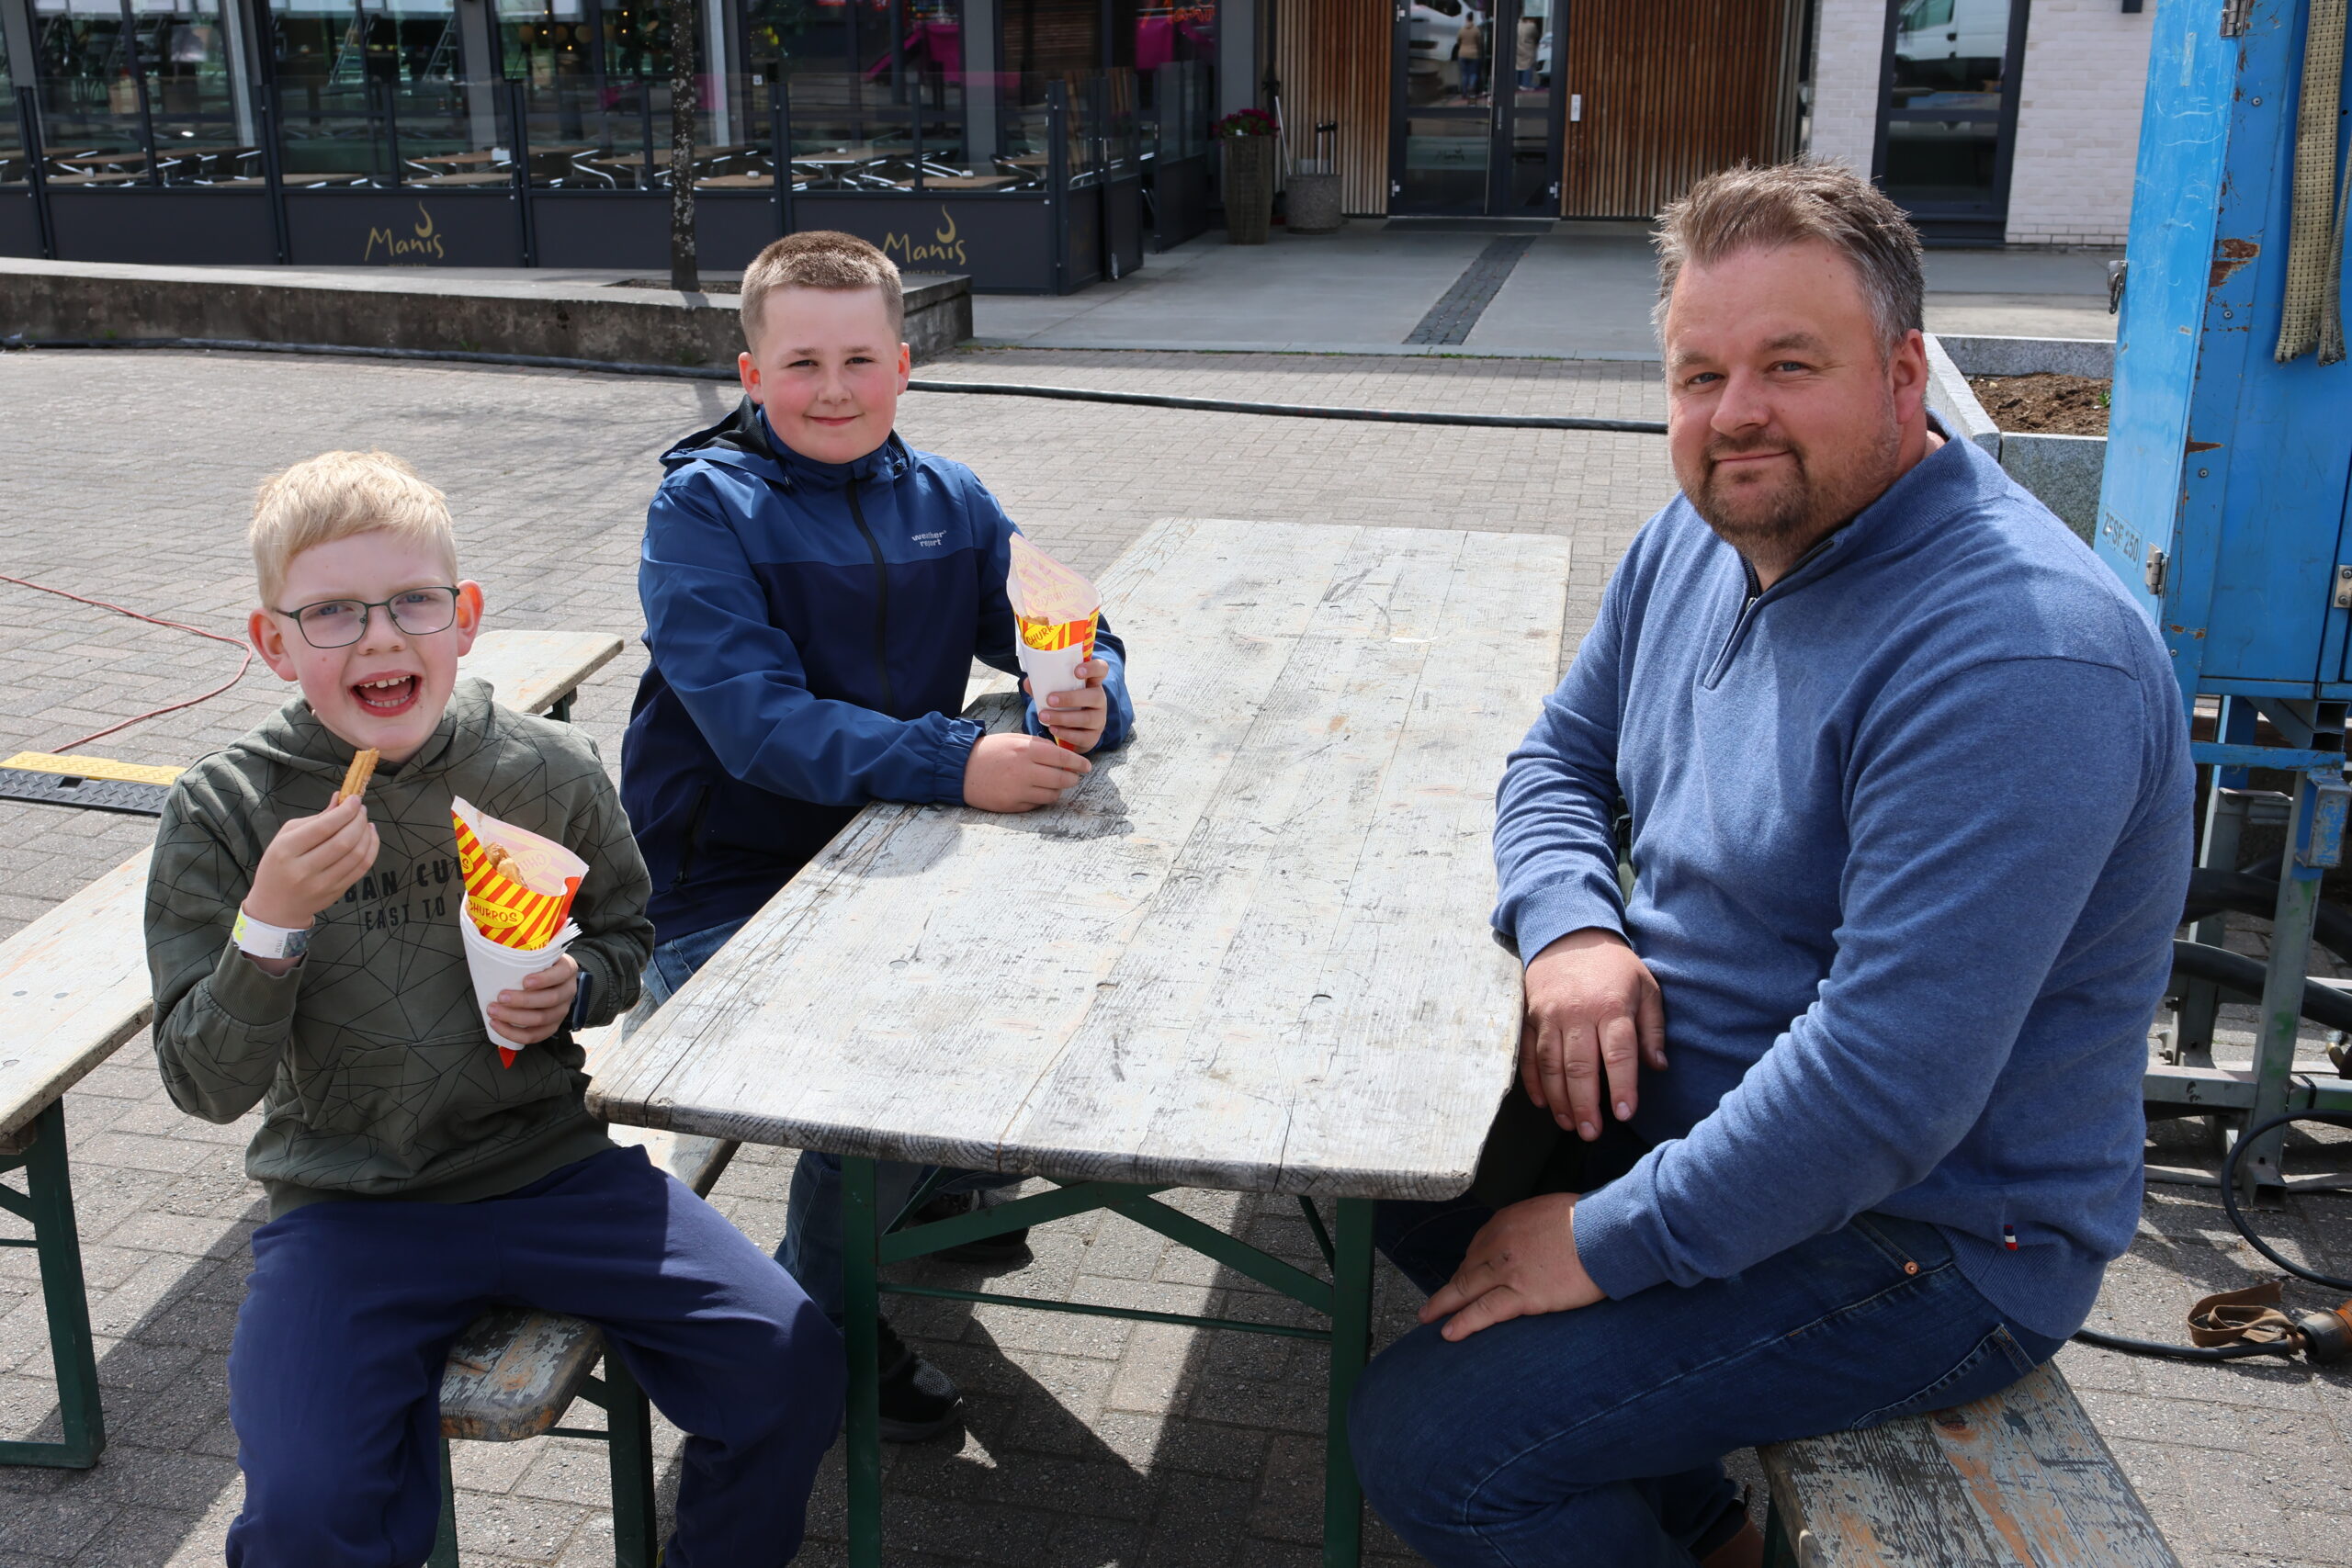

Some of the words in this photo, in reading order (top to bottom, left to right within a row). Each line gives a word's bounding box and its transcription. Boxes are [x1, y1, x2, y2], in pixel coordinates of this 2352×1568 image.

[365, 226, 444, 262] Manis
[883, 231, 967, 265] Manis
[911, 532, 944, 541] weather
[920, 538, 942, 548] report
[2123, 529, 2139, 563] 250
[334, 870, 398, 905] BAN
[365, 904, 410, 931] EAST
[422, 897, 446, 919] TO
[469, 899, 518, 923] CHURROS
